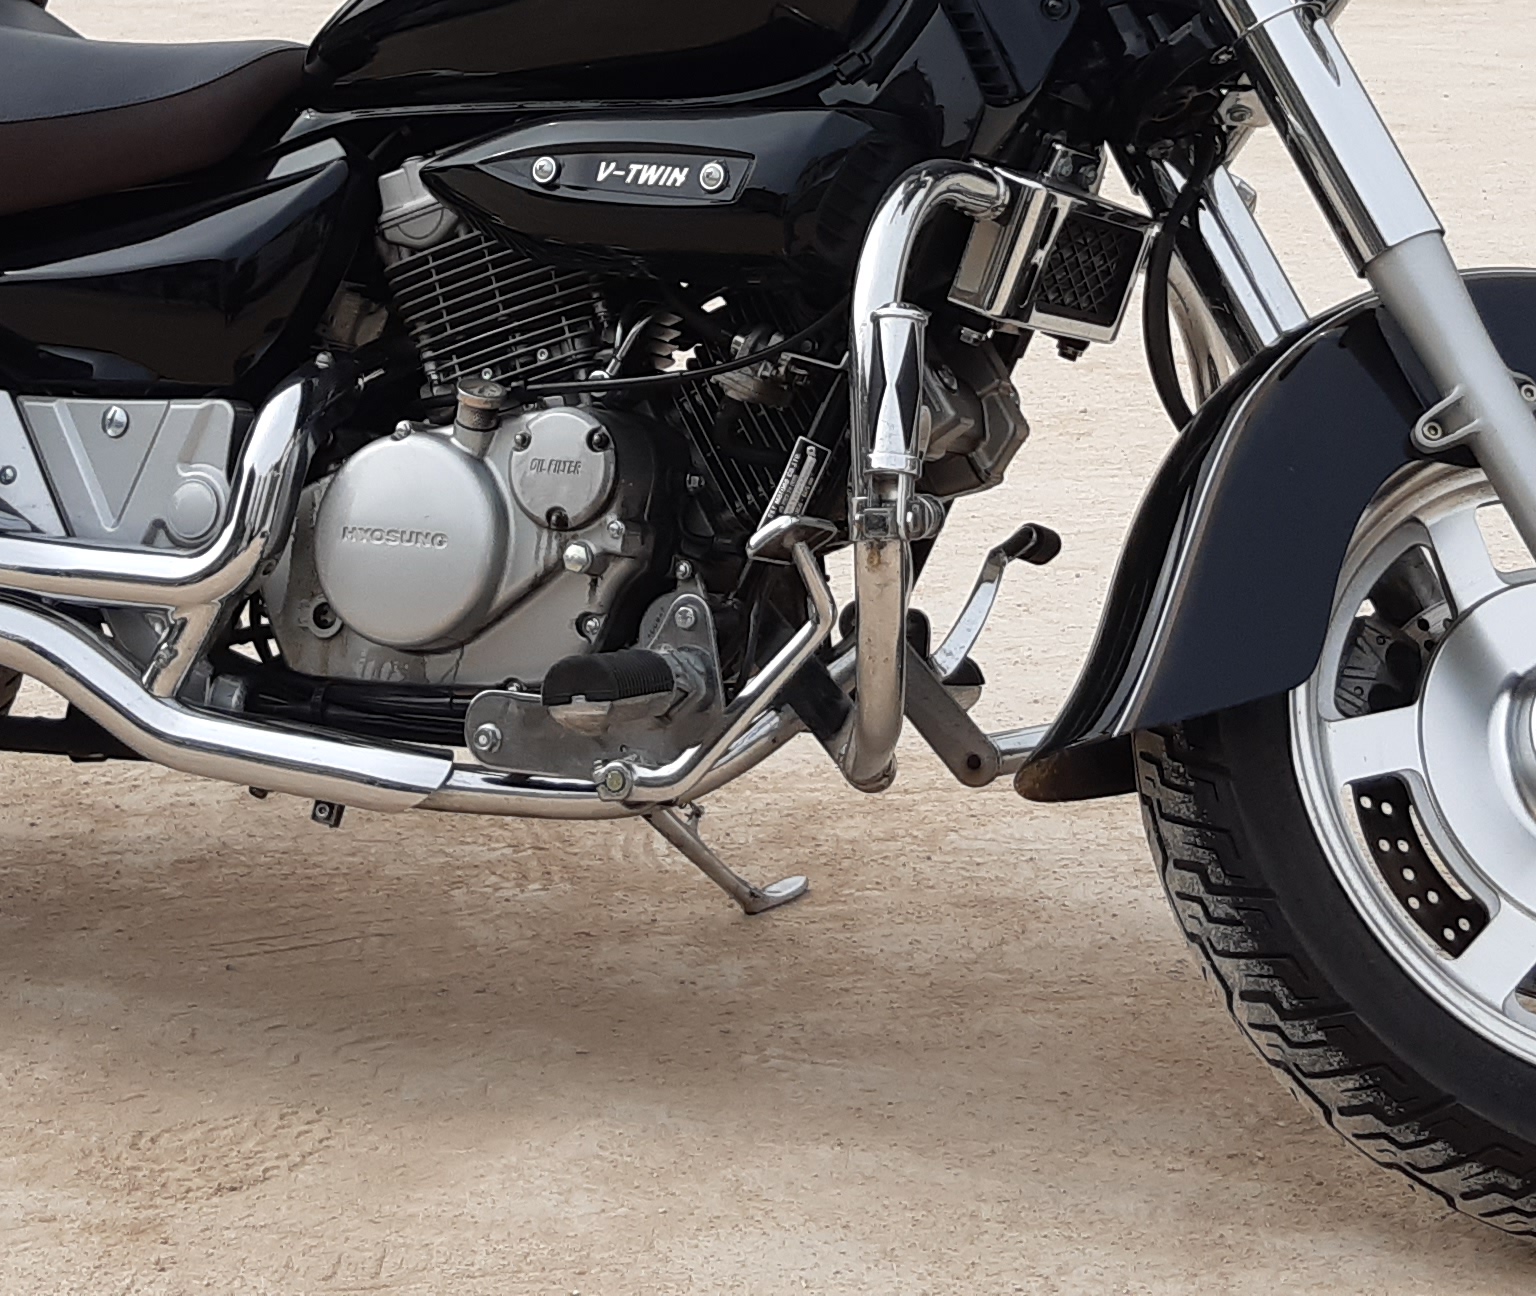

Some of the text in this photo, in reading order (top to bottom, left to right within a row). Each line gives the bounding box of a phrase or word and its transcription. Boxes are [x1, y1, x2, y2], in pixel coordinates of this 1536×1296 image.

[596, 161, 689, 187] V-TWIN
[529, 457, 582, 475] OIL FILTER
[342, 526, 449, 550] HYOSUNG
